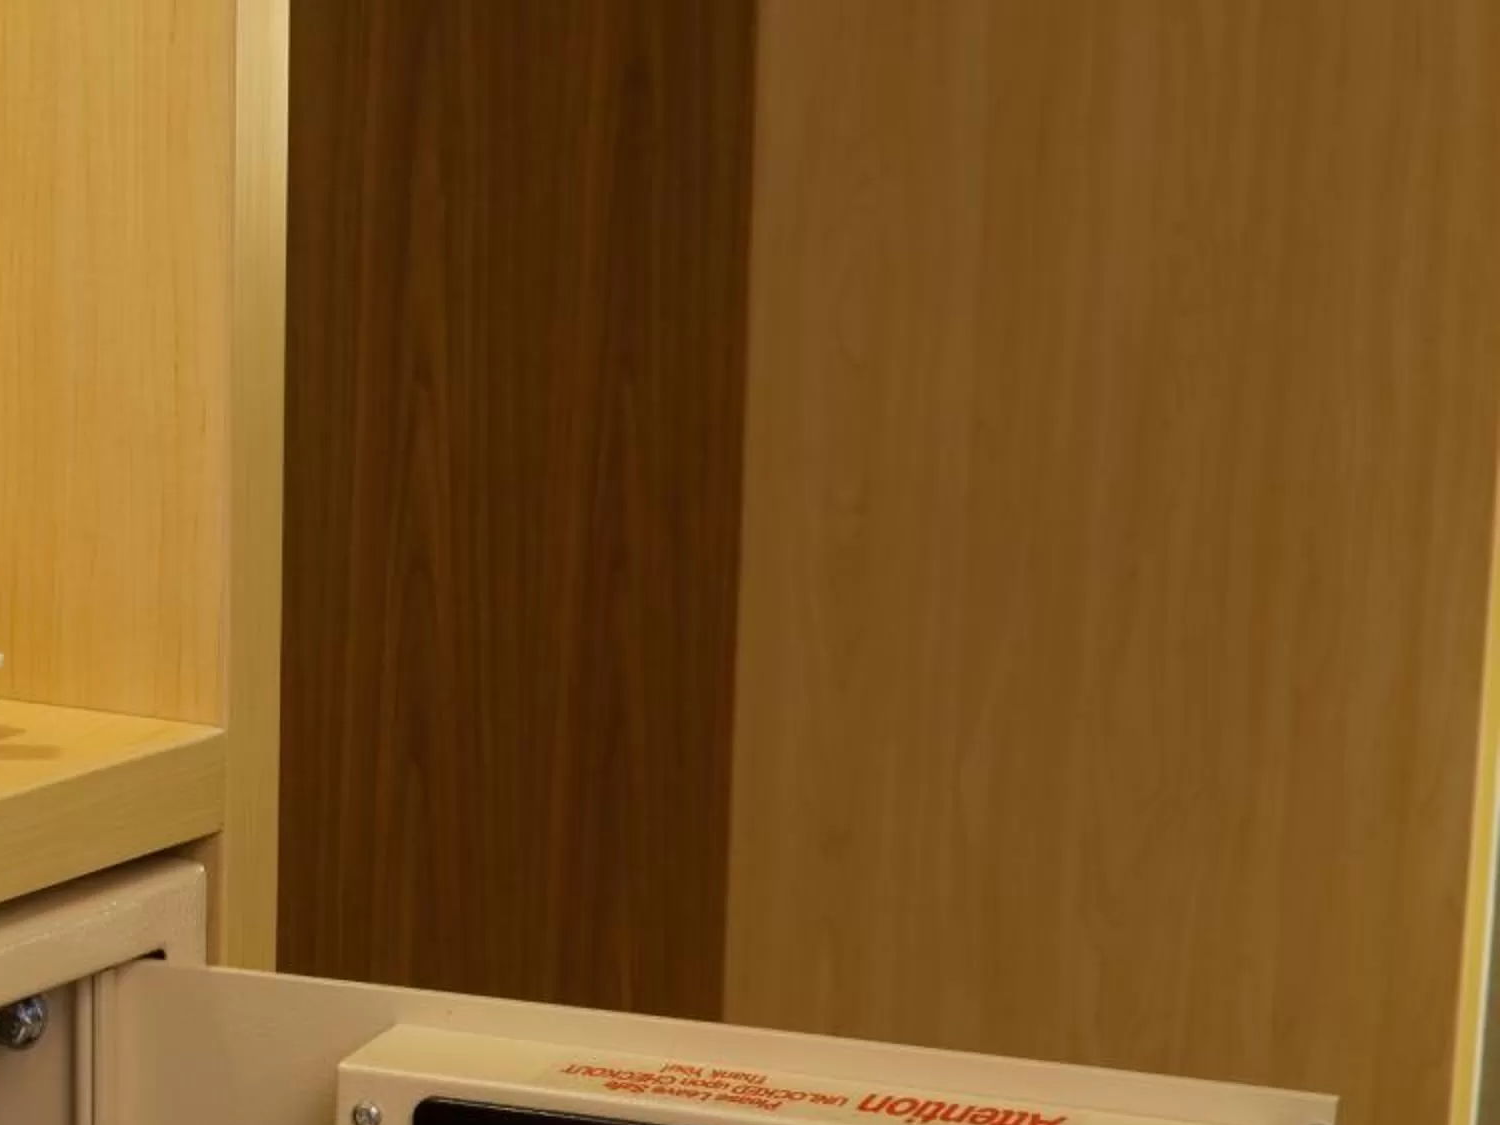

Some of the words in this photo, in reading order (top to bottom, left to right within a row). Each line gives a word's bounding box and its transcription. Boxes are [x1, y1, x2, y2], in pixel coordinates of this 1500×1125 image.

[560, 1063, 677, 1086] CHECKOUT
[710, 1068, 769, 1085] Thank
[602, 1080, 650, 1094] Safe
[679, 1077, 730, 1091] upon
[650, 1085, 712, 1101] Leave
[731, 1084, 849, 1107] UNLOCKED
[714, 1092, 783, 1112] Please
